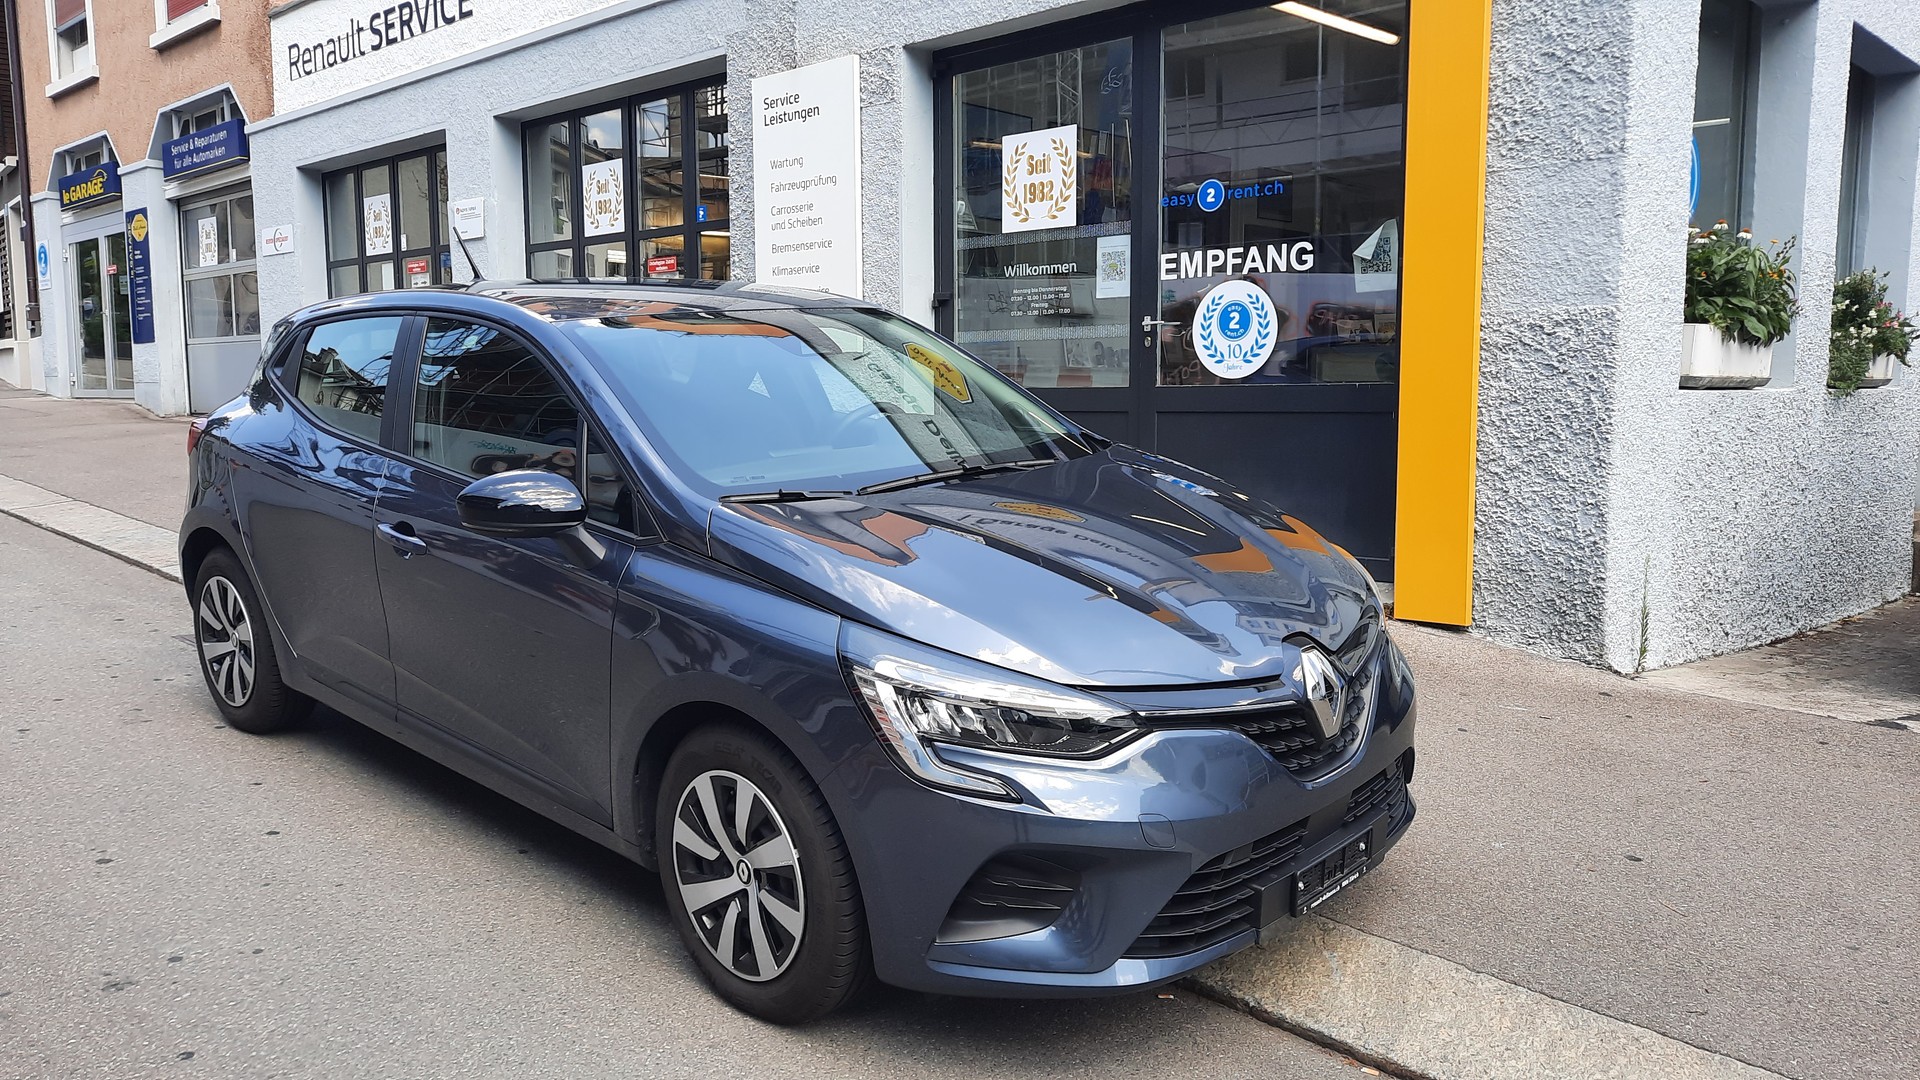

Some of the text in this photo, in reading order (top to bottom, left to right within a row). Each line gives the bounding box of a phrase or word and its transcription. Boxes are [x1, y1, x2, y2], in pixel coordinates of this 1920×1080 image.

[288, 0, 474, 81] Renault SERVICE
[763, 92, 800, 110] Service
[763, 106, 820, 127] Leistungen
[171, 130, 228, 156] Service & Reparaturen
[174, 146, 226, 169] für alle Automarken
[769, 156, 804, 170] Wartung
[1026, 153, 1052, 176] Seit
[70, 178, 104, 202] GARAGE
[595, 178, 610, 195] Seit
[770, 174, 837, 193] Fahrzeugprüfung
[1023, 180, 1054, 204] 1982
[1161, 180, 1284, 207] easy 2 rent.ch
[594, 199, 612, 216] 1982
[770, 201, 814, 216] Carrosserie
[771, 216, 823, 231] und Scheiben
[771, 238, 833, 254] Bremsenservice
[771, 263, 820, 277] Klimaservice
[1003, 262, 1077, 278] Willkommen
[1160, 241, 1314, 281] EMPFANG
[1228, 311, 1240, 329] 2
[1224, 328, 1245, 337] rent.ch
[1227, 343, 1243, 359] 10
[1223, 363, 1243, 373] Jahre
